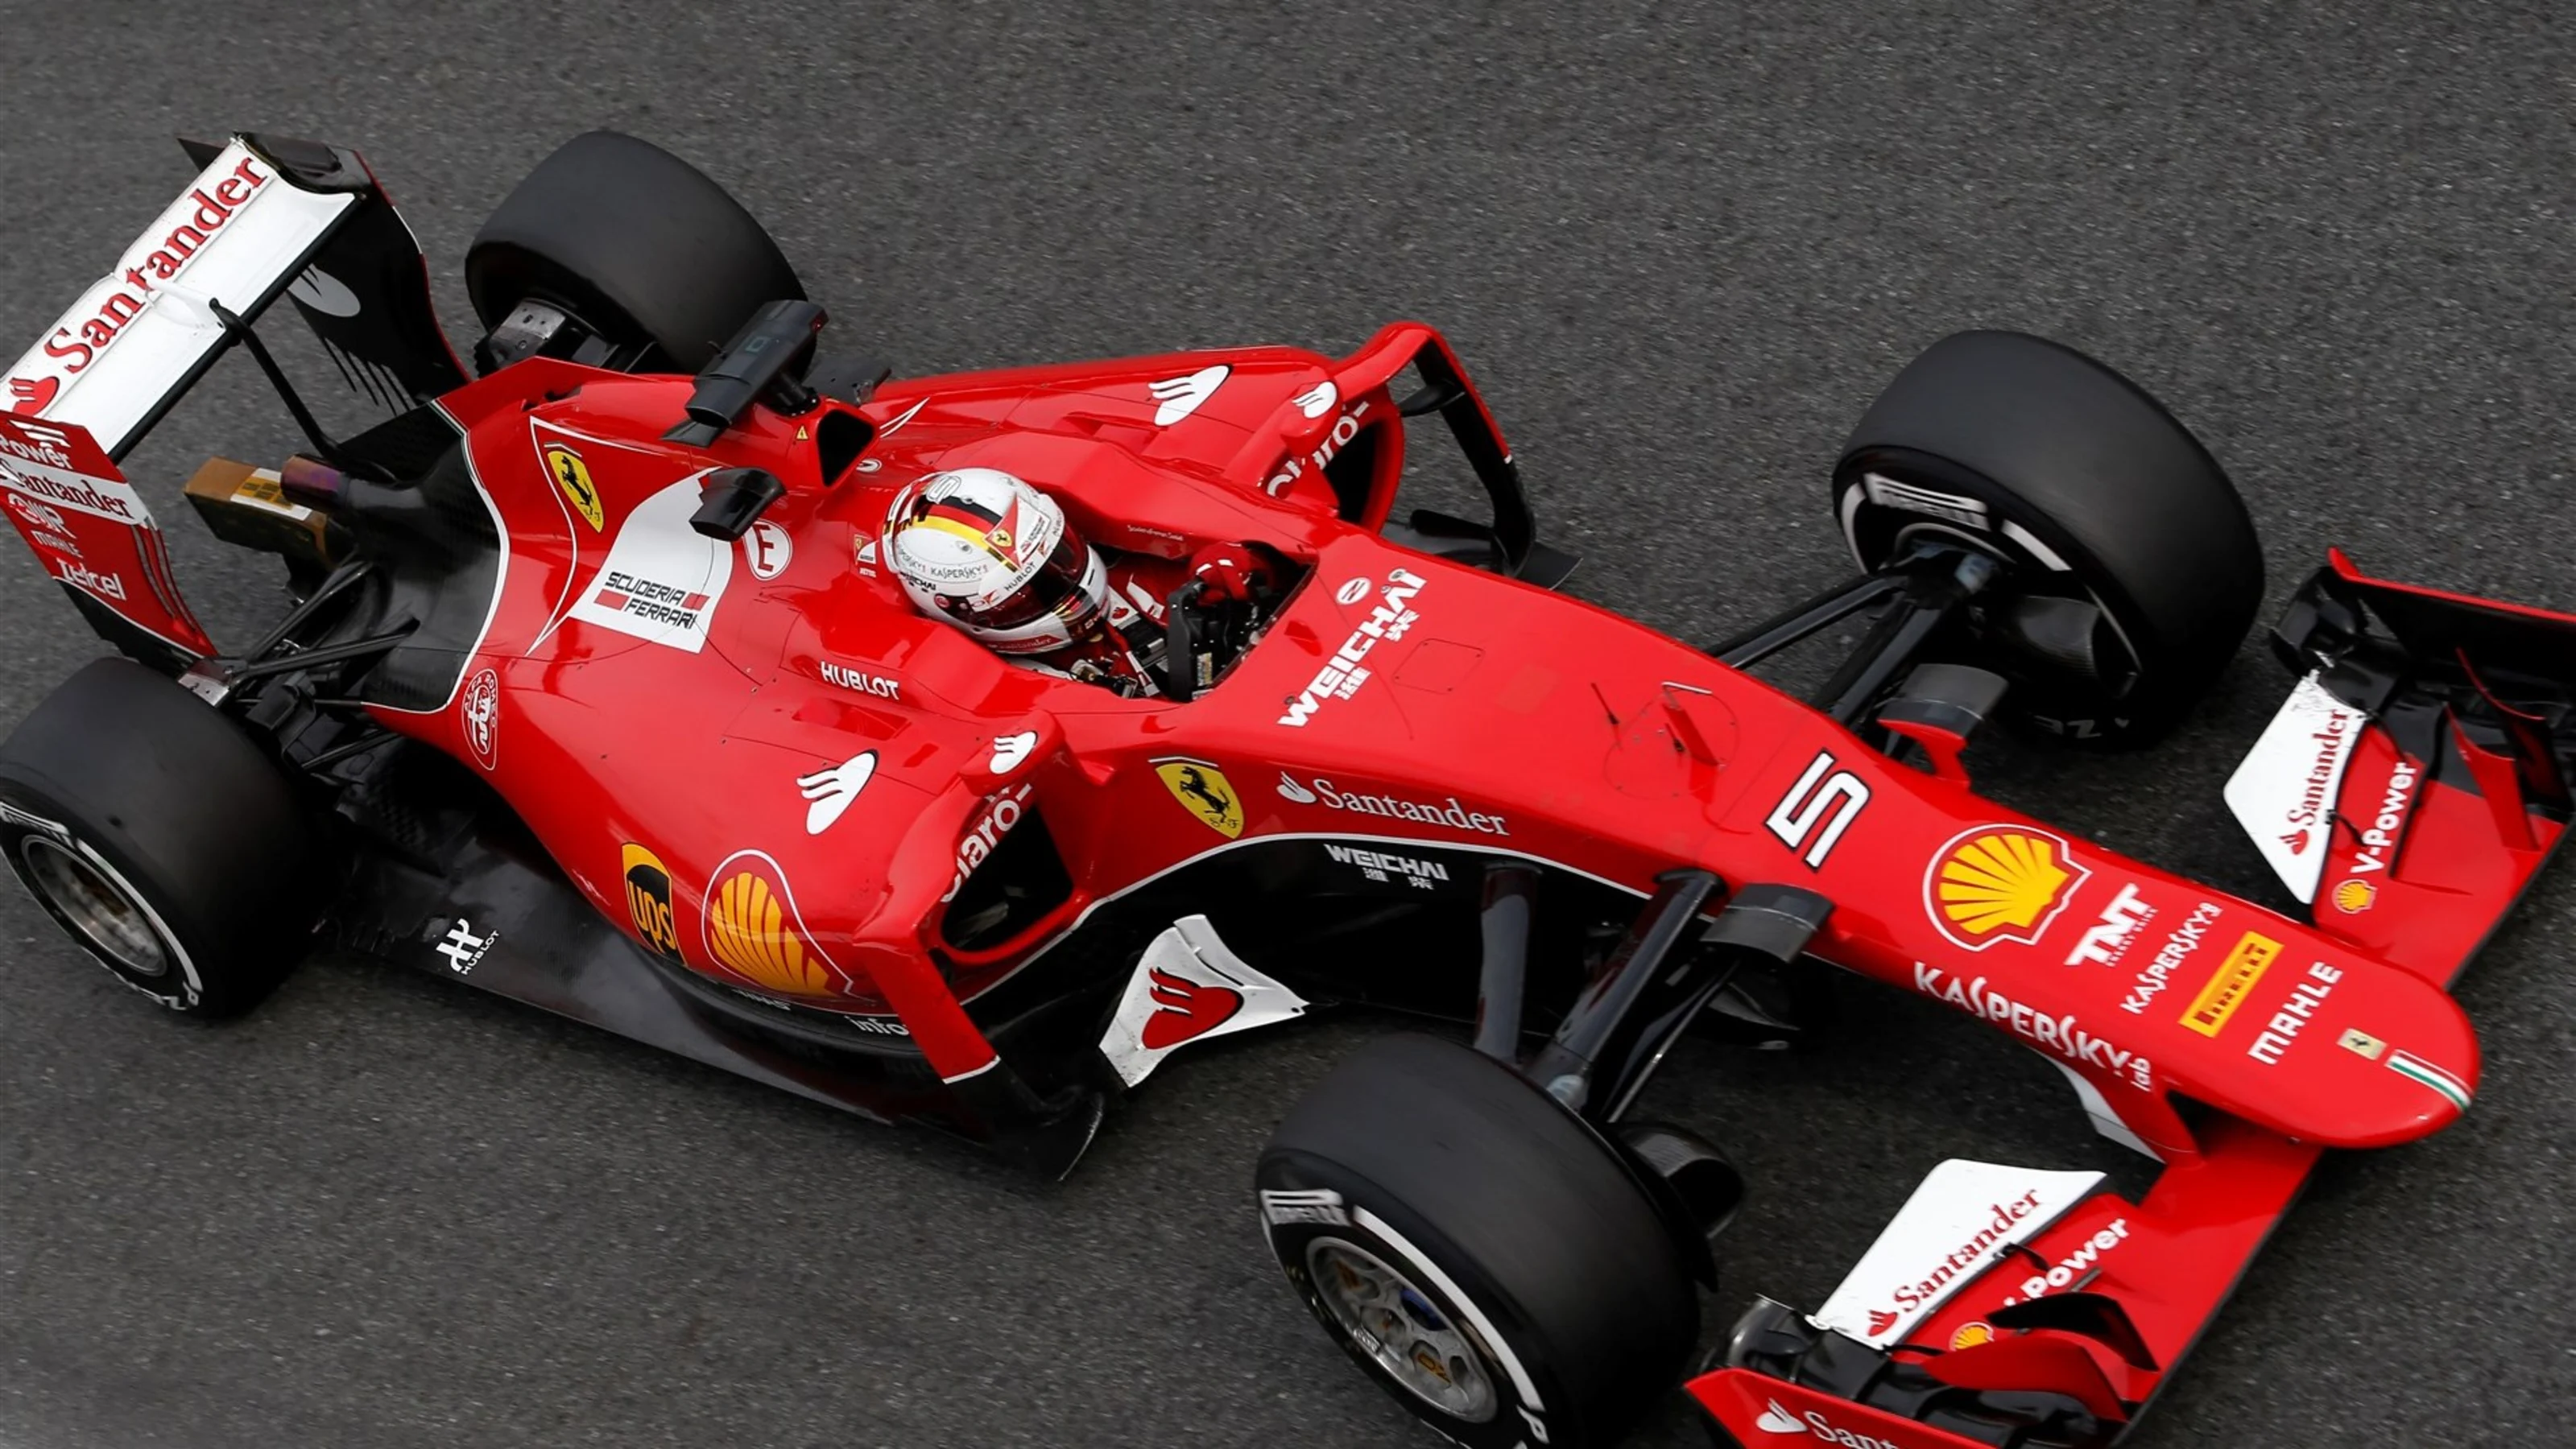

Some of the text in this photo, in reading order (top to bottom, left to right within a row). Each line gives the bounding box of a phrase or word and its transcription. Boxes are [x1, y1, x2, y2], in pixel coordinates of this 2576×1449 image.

[44, 155, 268, 374] Santander
[56, 557, 126, 601] Telcel
[752, 524, 774, 572] E
[1003, 561, 1036, 592] HUBLOT
[605, 572, 686, 605] SCUDERIA
[624, 598, 698, 630] FERRARI
[821, 661, 899, 700] HUBLOT
[1277, 570, 1428, 727] WEICHAI
[1313, 778, 1511, 836] Santander
[2285, 708, 2349, 827] Santander
[1763, 748, 1872, 872] 5
[2350, 762, 2417, 874] V-Power
[1323, 843, 1449, 881] WEICHAI
[461, 930, 499, 975] HUBLOT
[628, 880, 676, 956] ups
[2063, 881, 2152, 966] TNT
[2119, 907, 2214, 1014] KASPERSKY
[1914, 961, 2152, 1092] KASPERSKY lab
[2247, 961, 2344, 1065] MAHLE
[1894, 1189, 2041, 1312] Santander
